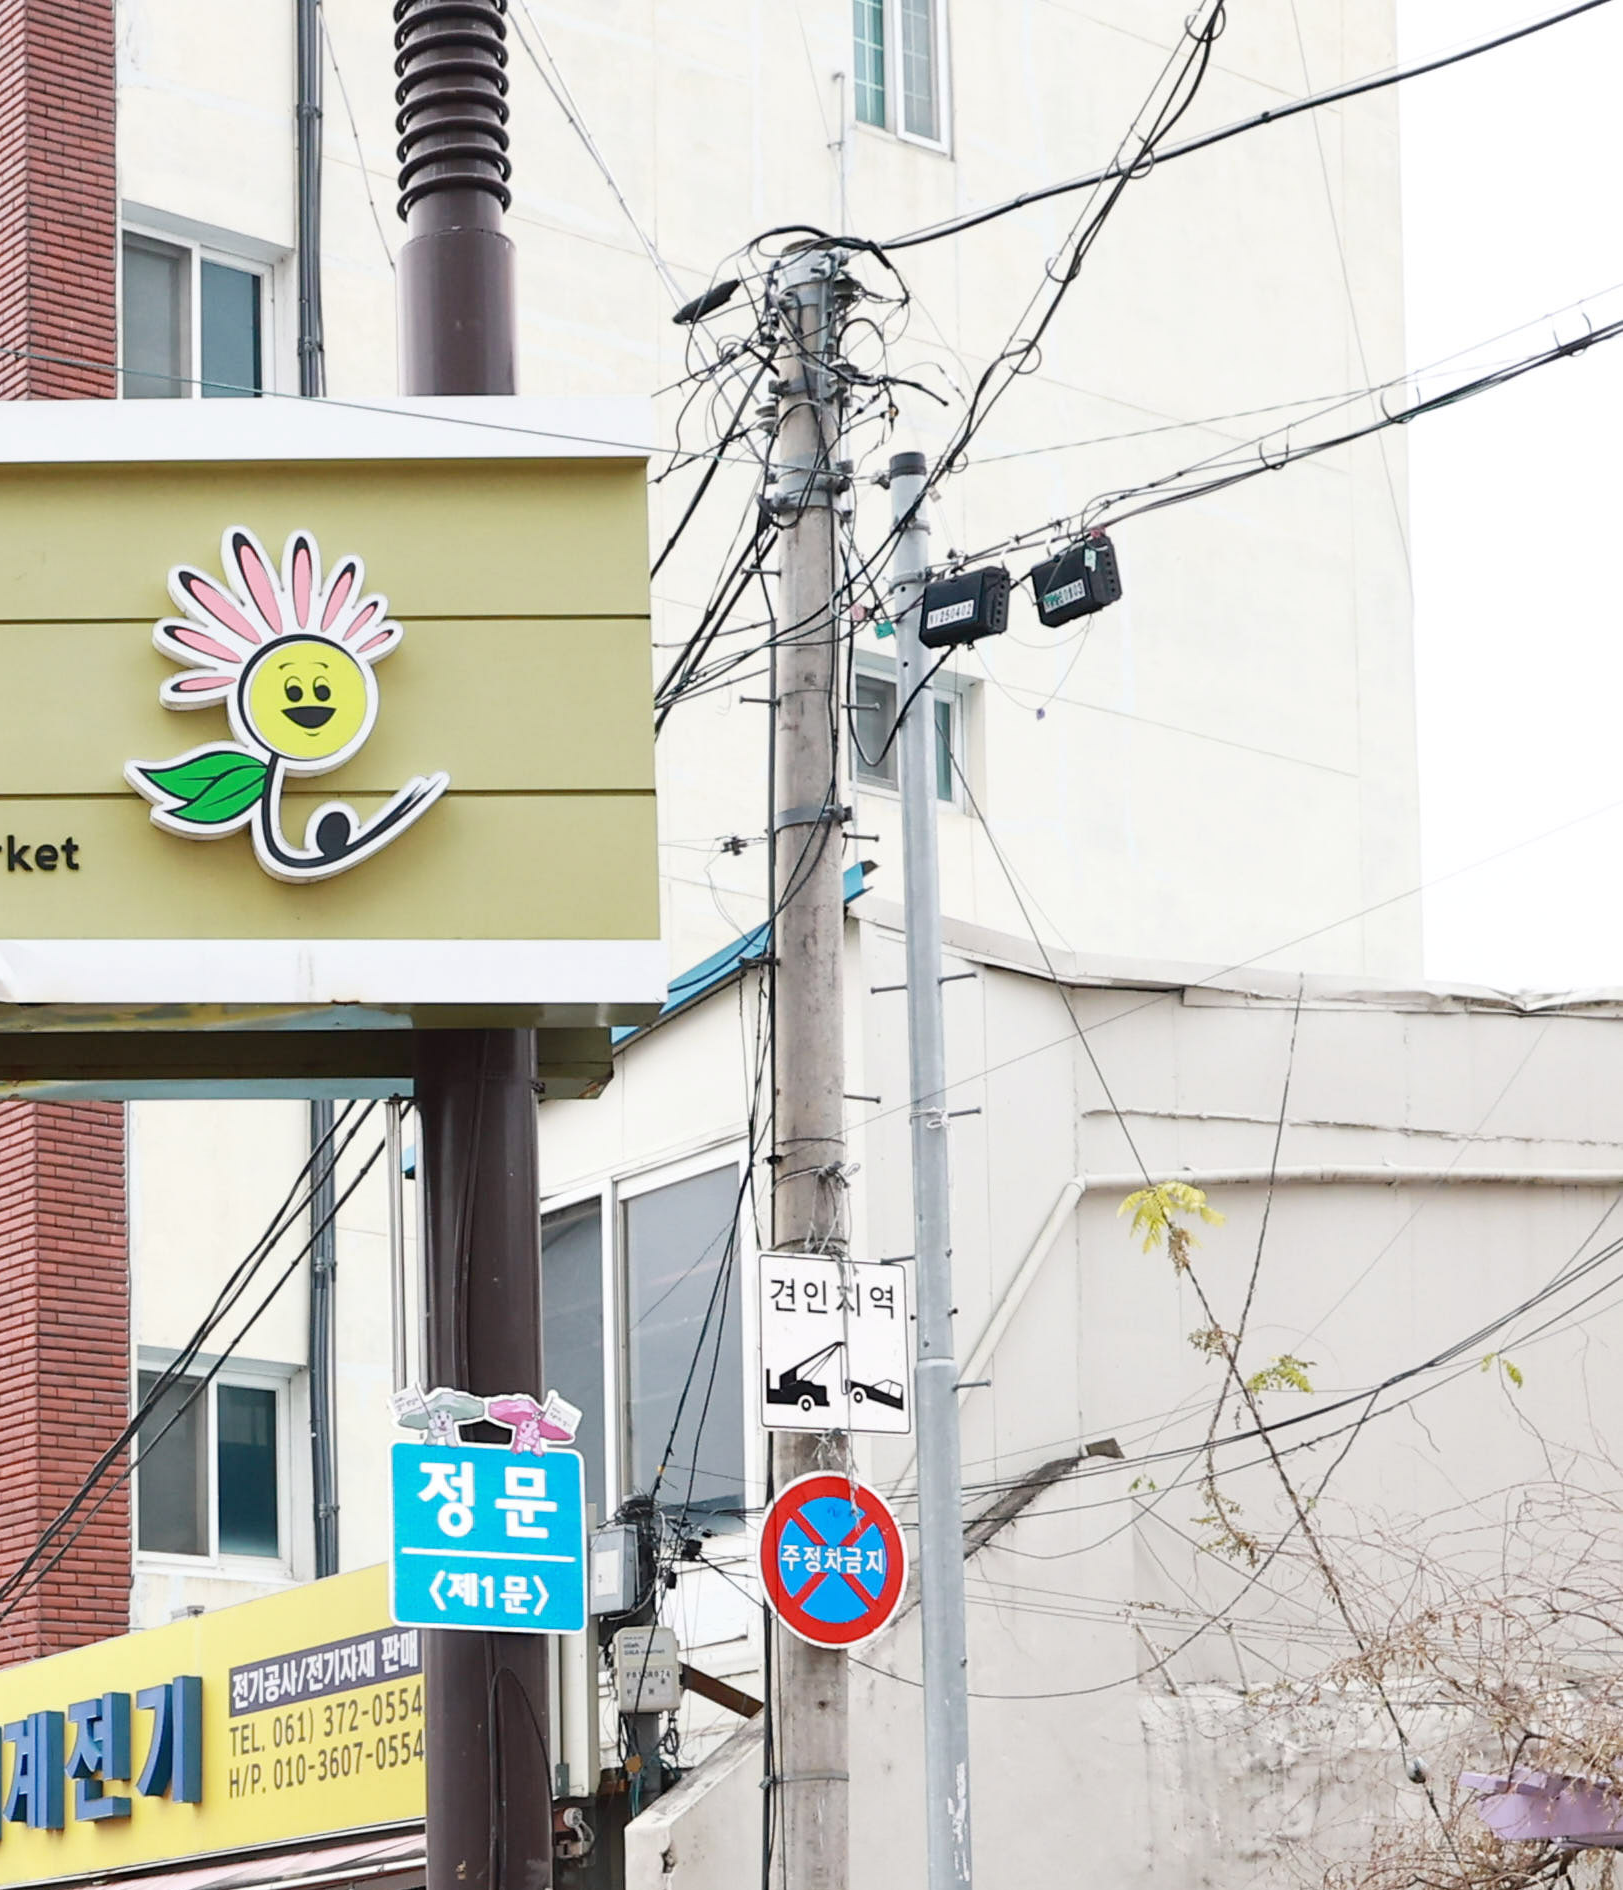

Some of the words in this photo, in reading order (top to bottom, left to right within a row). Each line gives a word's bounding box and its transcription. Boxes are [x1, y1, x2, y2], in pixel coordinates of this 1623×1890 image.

[770, 1278, 894, 1320] 견인지역
[780, 1544, 885, 1576] 주정차금지
[232, 1640, 376, 1710] 전기공사/전기자재
[381, 1629, 419, 1674] 판매
[229, 1722, 266, 1758] TEL.
[273, 1706, 314, 1749] 061)
[324, 1684, 423, 1738] 372-0554
[229, 1762, 267, 1799] H/P.
[274, 1728, 425, 1791] 010-3607-0554
